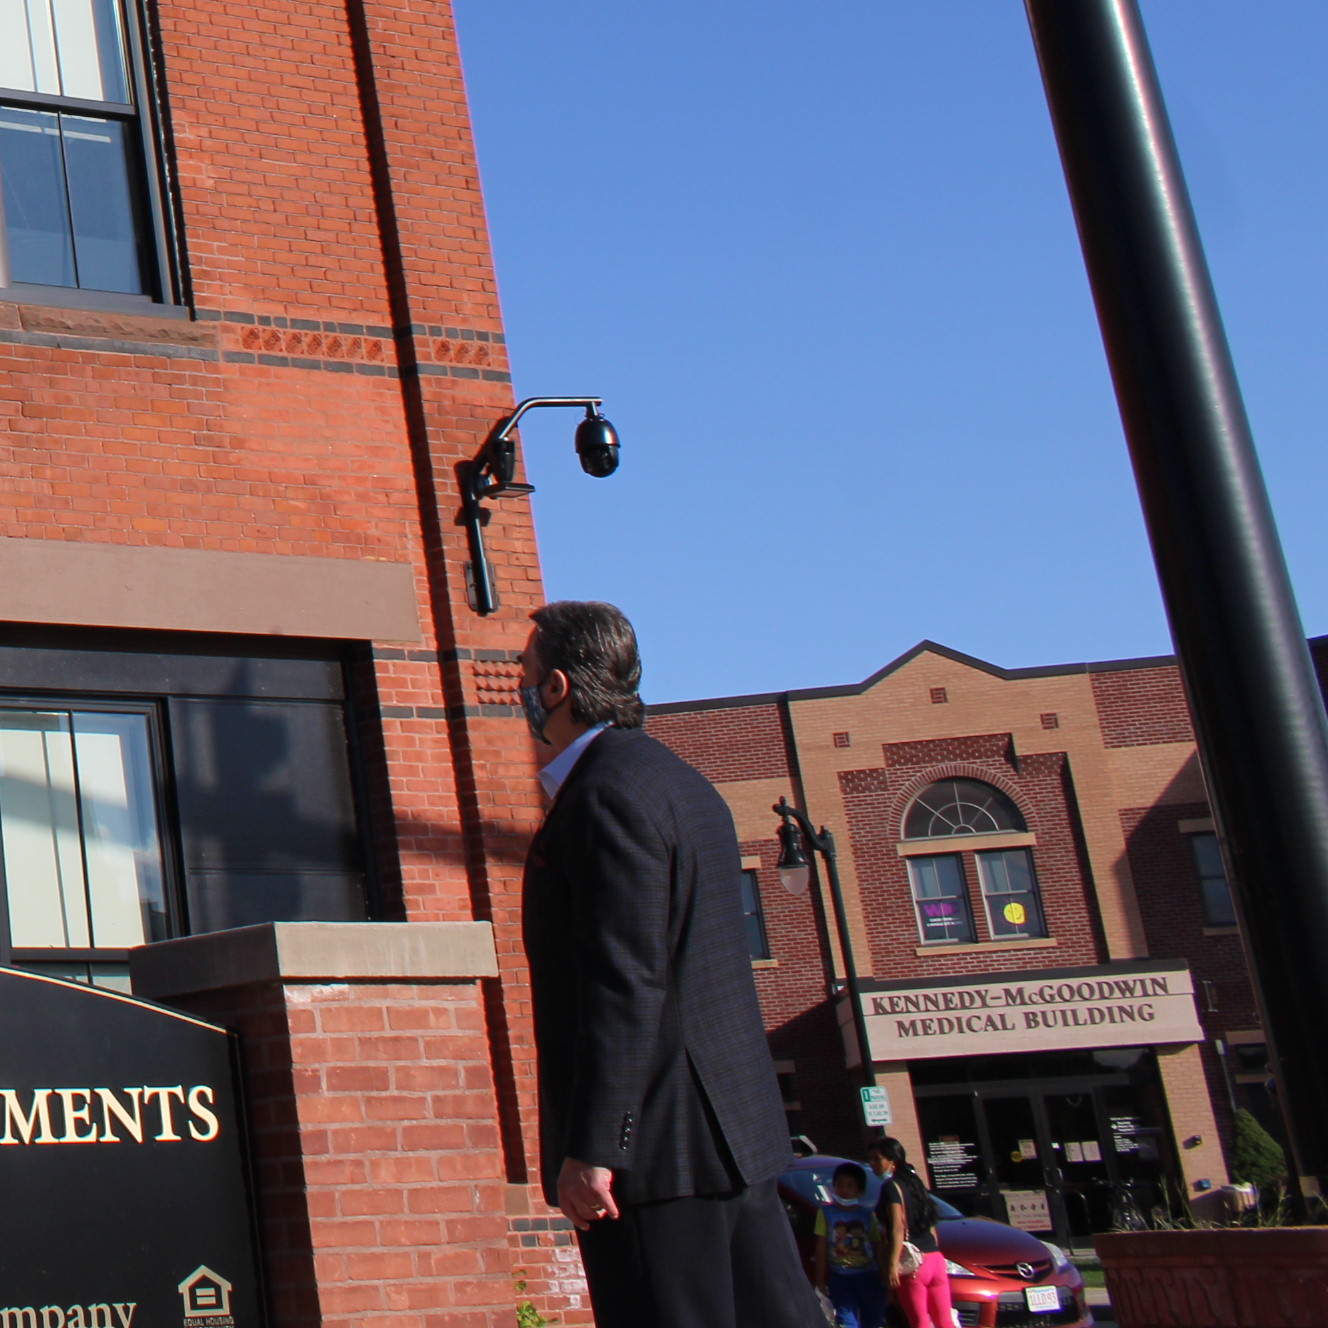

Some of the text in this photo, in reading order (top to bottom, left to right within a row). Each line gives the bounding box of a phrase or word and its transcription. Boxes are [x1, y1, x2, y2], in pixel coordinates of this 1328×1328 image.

[895, 1003, 1156, 1038] MEDICAL BUILDING
[184, 1316, 234, 1327] EQUAL HOUSING
